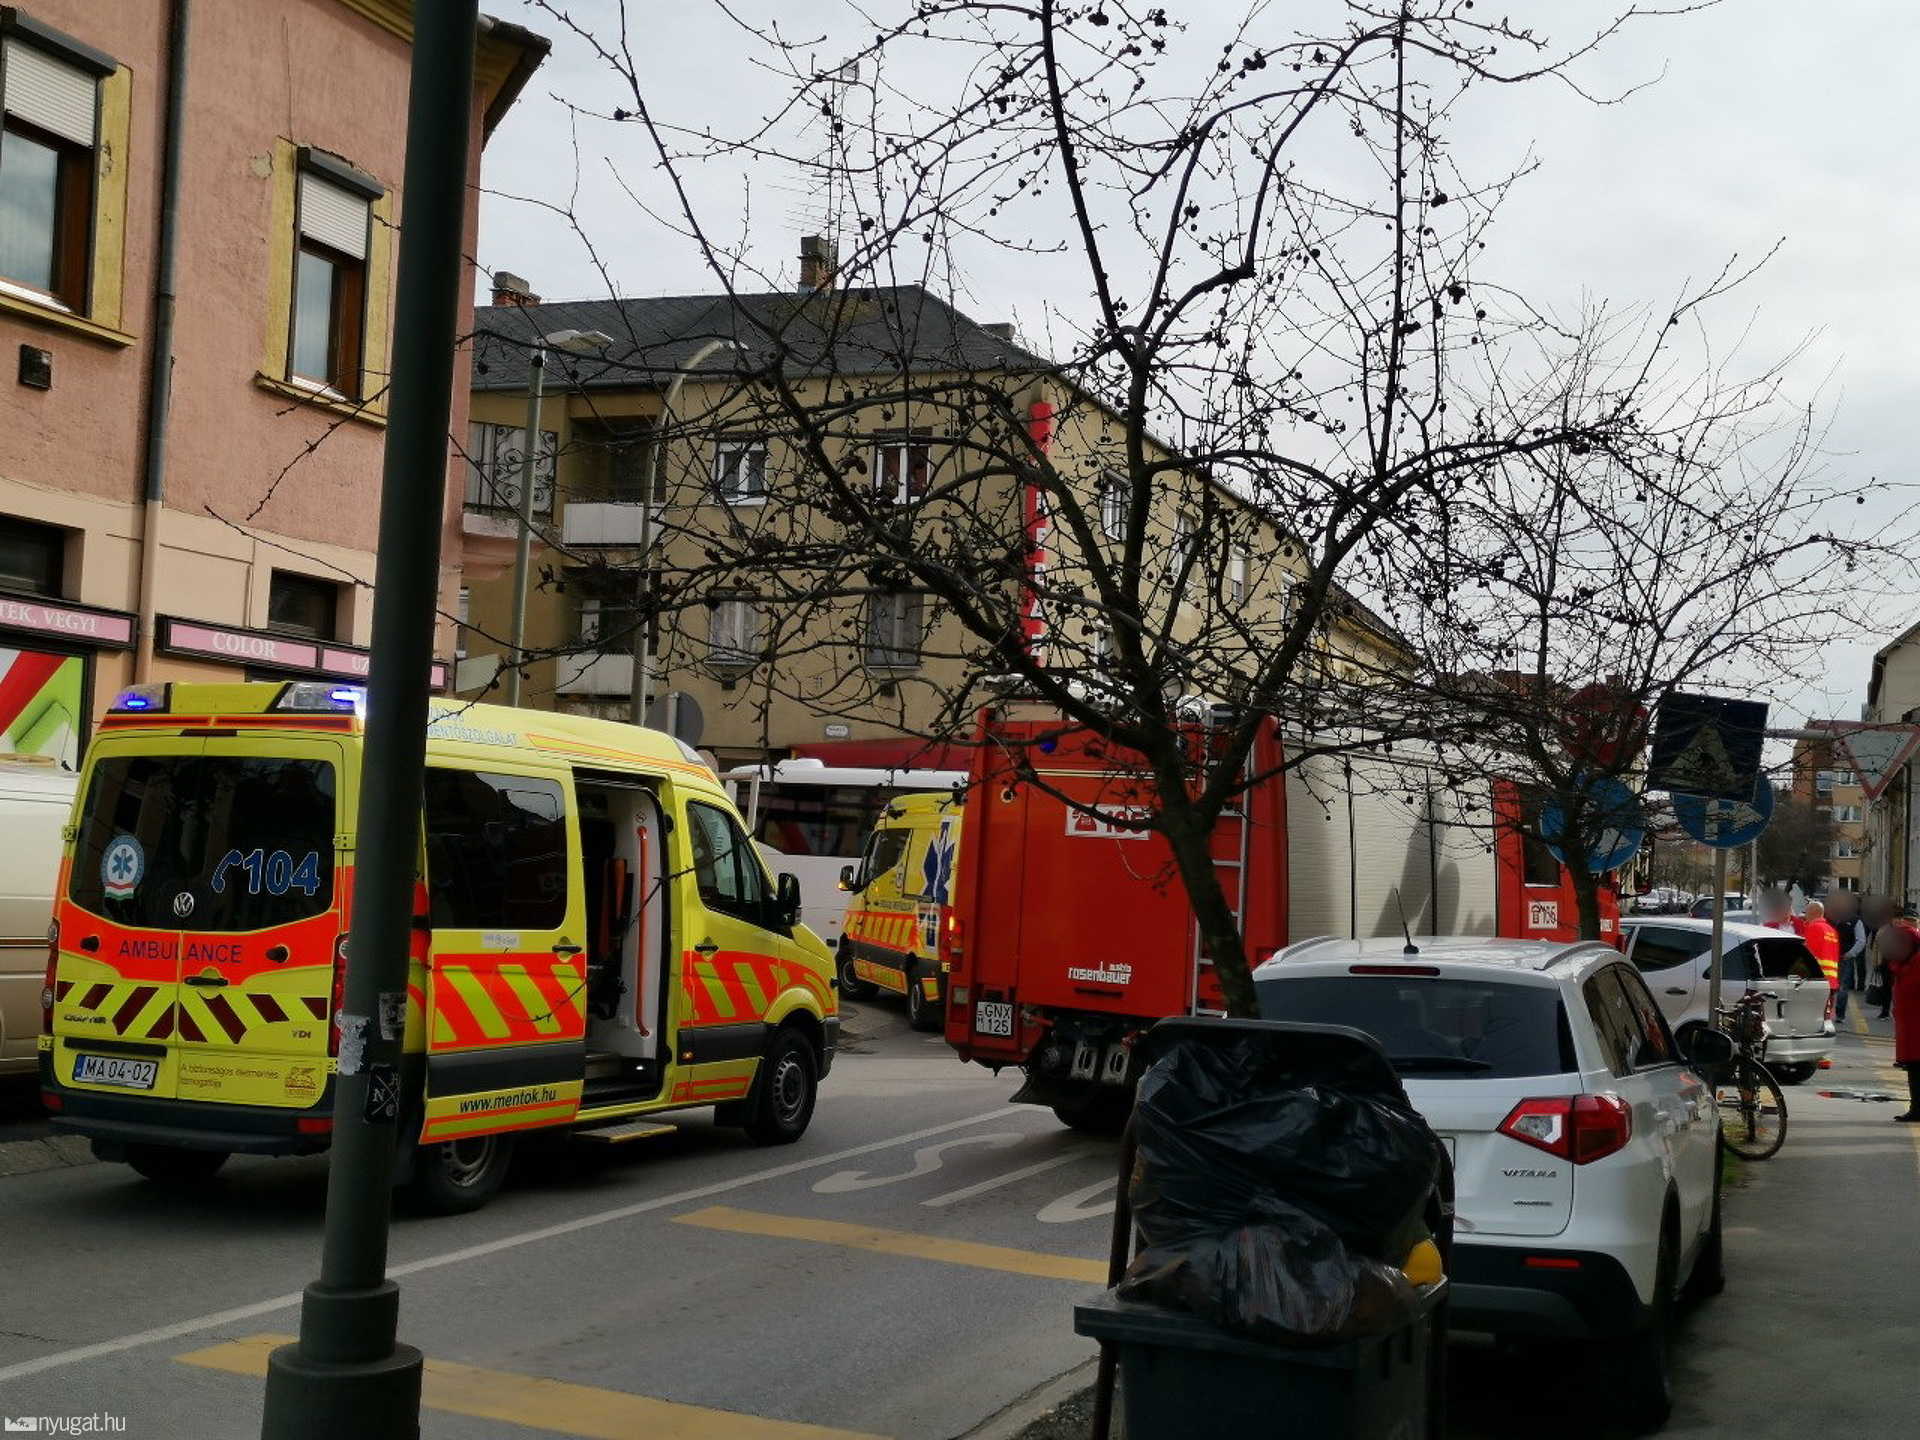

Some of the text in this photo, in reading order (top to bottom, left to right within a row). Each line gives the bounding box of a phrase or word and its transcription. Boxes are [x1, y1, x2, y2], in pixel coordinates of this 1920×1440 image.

[212, 632, 277, 658] COLOR
[242, 848, 320, 896] 104
[118, 938, 243, 964] AMBULANCE
[1067, 960, 1132, 985] rosenbauer
[984, 1004, 1011, 1020] GNX
[988, 1018, 1009, 1034] 125
[85, 1058, 152, 1082] MA 04-02
[459, 1086, 557, 1113] www.mentok.hu
